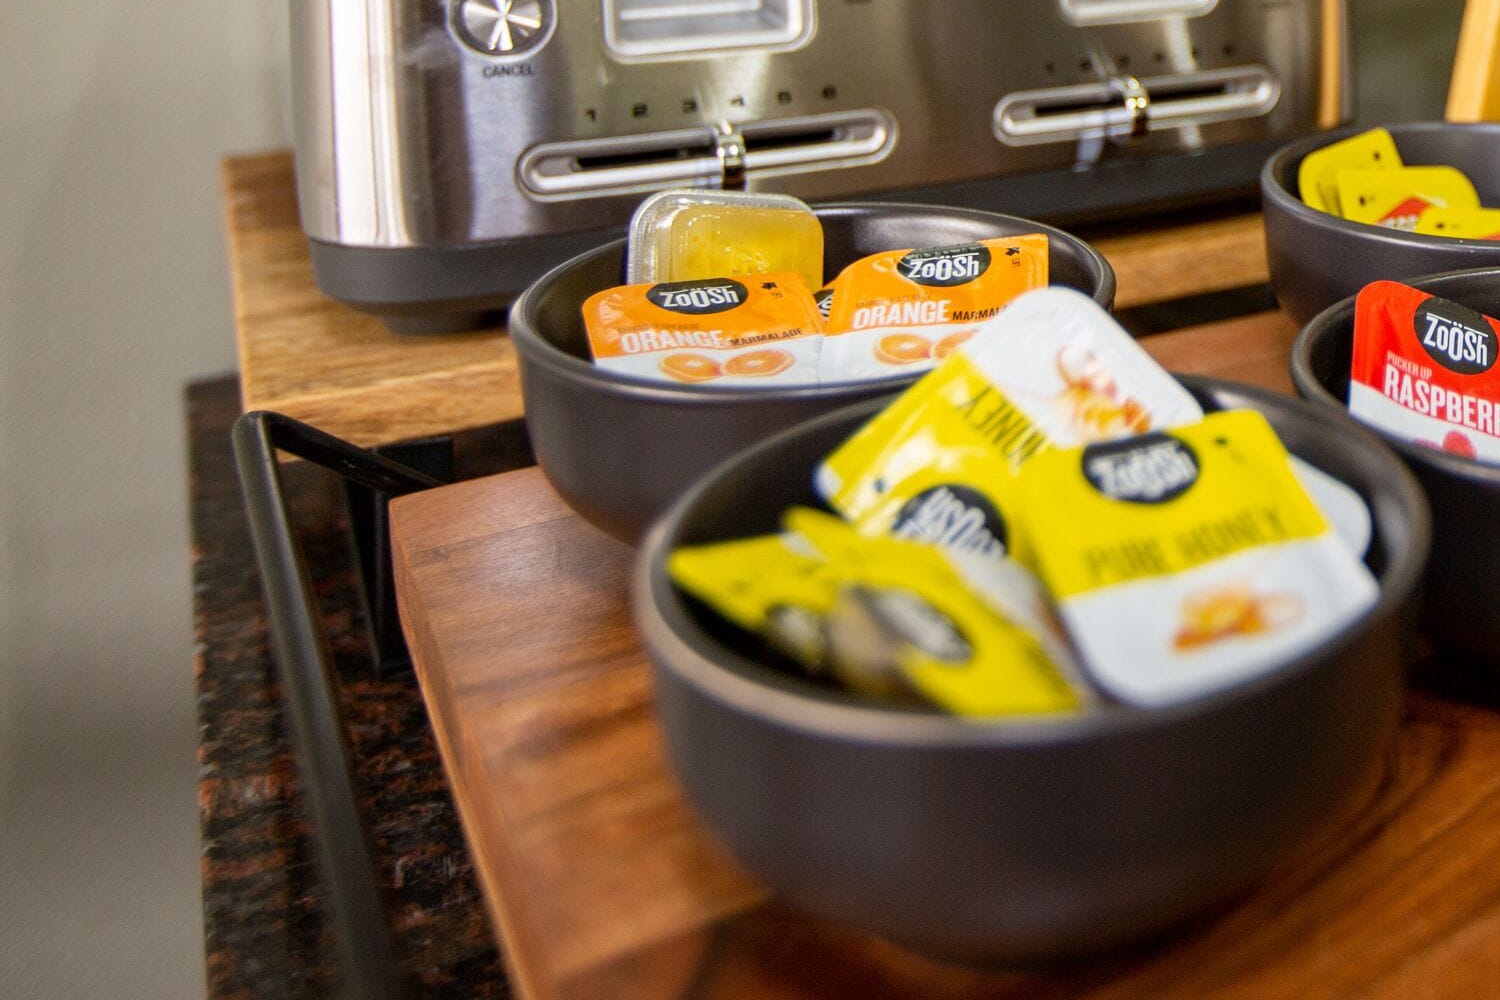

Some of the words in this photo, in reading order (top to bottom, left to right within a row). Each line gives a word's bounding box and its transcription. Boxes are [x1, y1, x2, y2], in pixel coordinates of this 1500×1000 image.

[482, 63, 536, 79] CANCEL
[852, 299, 951, 329] ORANGE
[619, 330, 724, 353] ORANGE
[729, 328, 804, 347] MARMALADE
[1386, 350, 1419, 376] PUCKER
[1420, 365, 1433, 380] UP
[1081, 536, 1168, 584] PURE
[1173, 504, 1288, 562] HONEY
